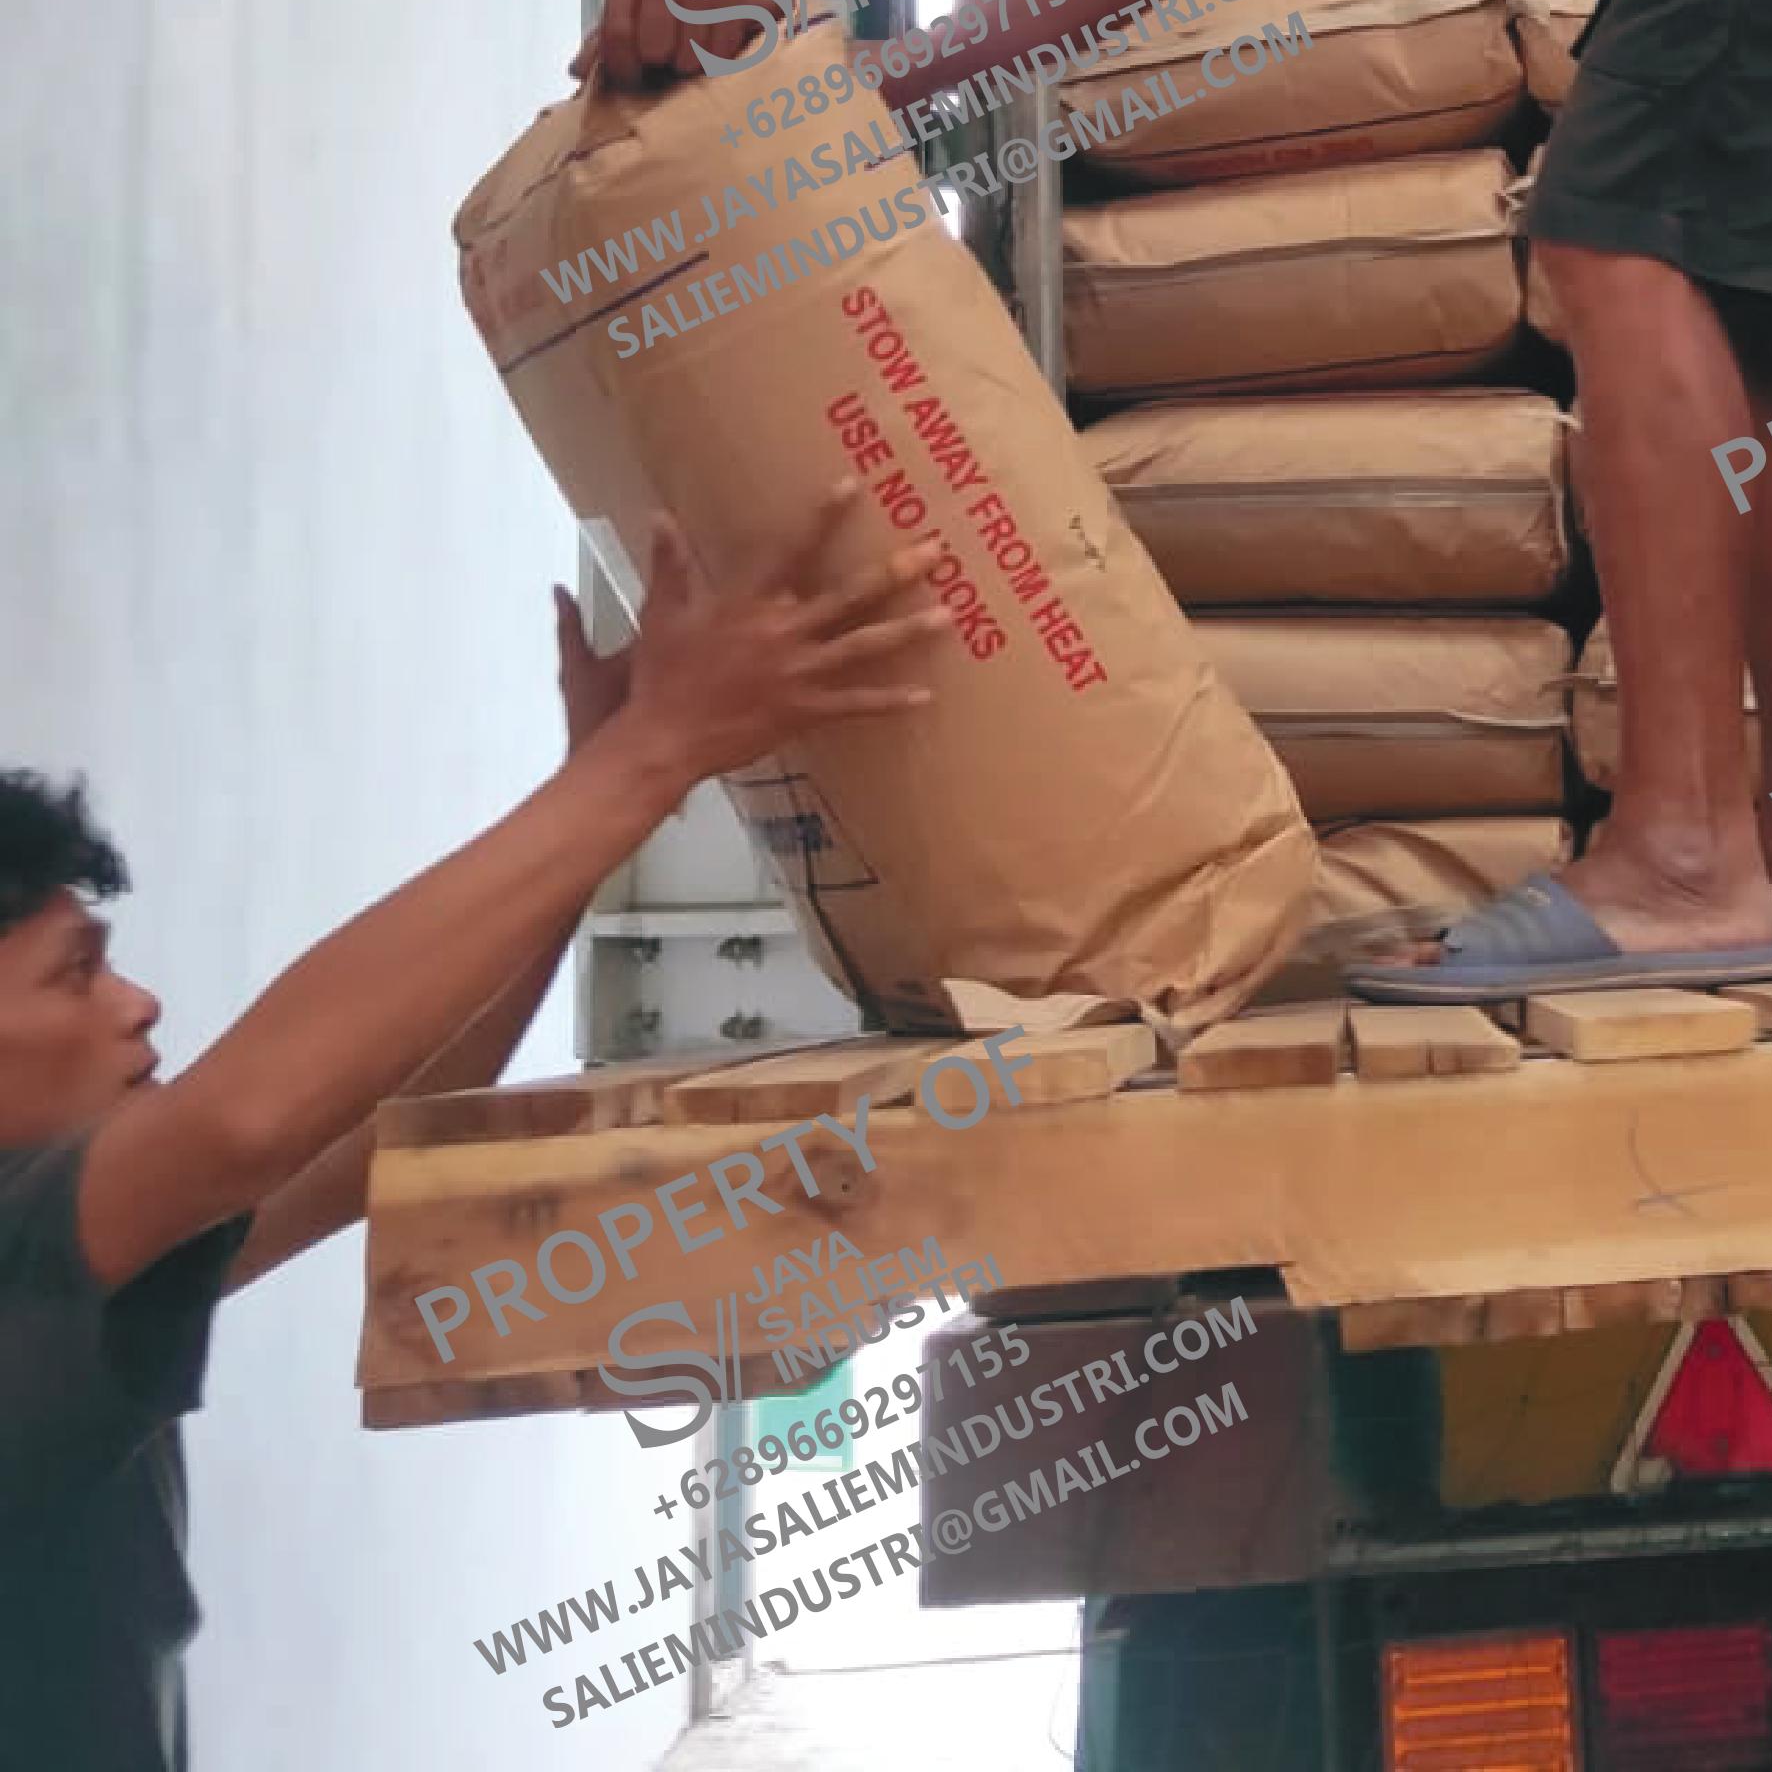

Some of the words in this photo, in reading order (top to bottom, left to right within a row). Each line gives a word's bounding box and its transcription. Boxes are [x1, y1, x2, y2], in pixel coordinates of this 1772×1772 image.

[826, 391, 896, 477] USE
[872, 467, 930, 531] NO
[841, 285, 929, 395] STOW
[904, 395, 990, 494] AWAY
[966, 491, 1051, 605] FROM
[1029, 596, 1109, 693] HEAT
